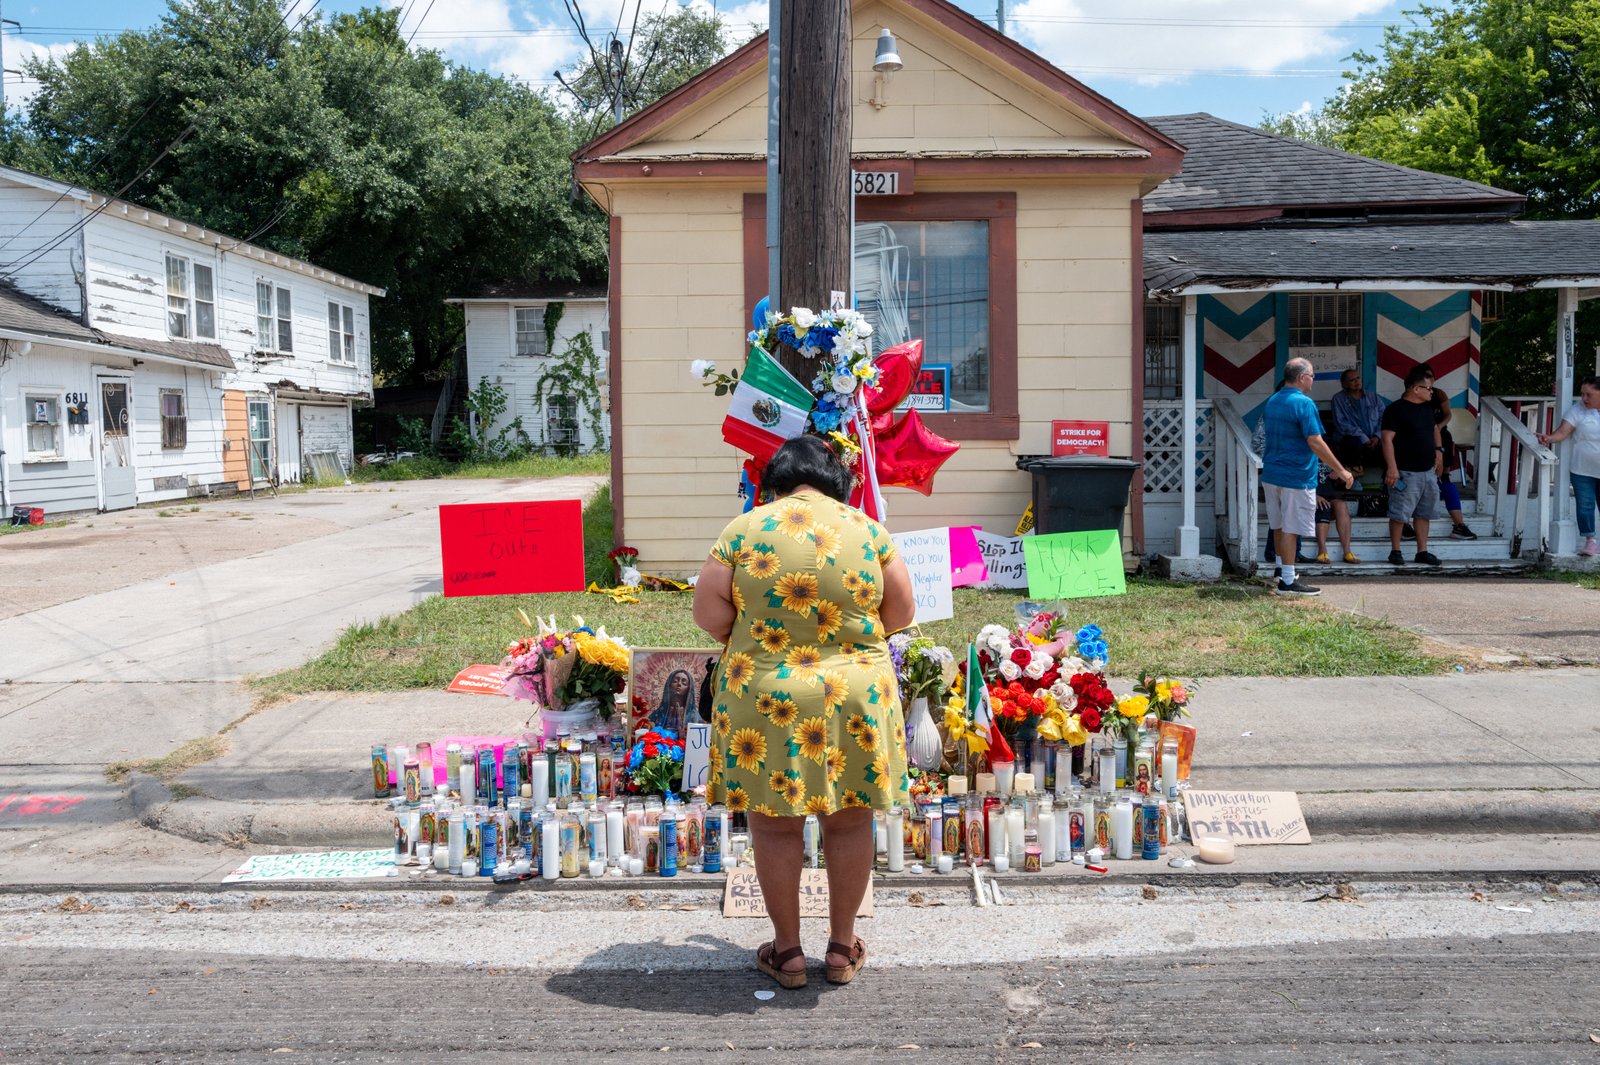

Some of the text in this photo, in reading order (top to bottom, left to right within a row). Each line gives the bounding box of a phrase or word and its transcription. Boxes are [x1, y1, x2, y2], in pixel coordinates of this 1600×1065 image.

[855, 173, 896, 194] 6821
[1564, 315, 1573, 367] 6821
[65, 392, 88, 404] 6811
[470, 505, 544, 537] ICE
[903, 537, 930, 549] KNOW
[931, 535, 947, 546] YOU
[978, 539, 1006, 557] Stop
[928, 554, 943, 563] YOU
[1191, 820, 1272, 839] DEATH
